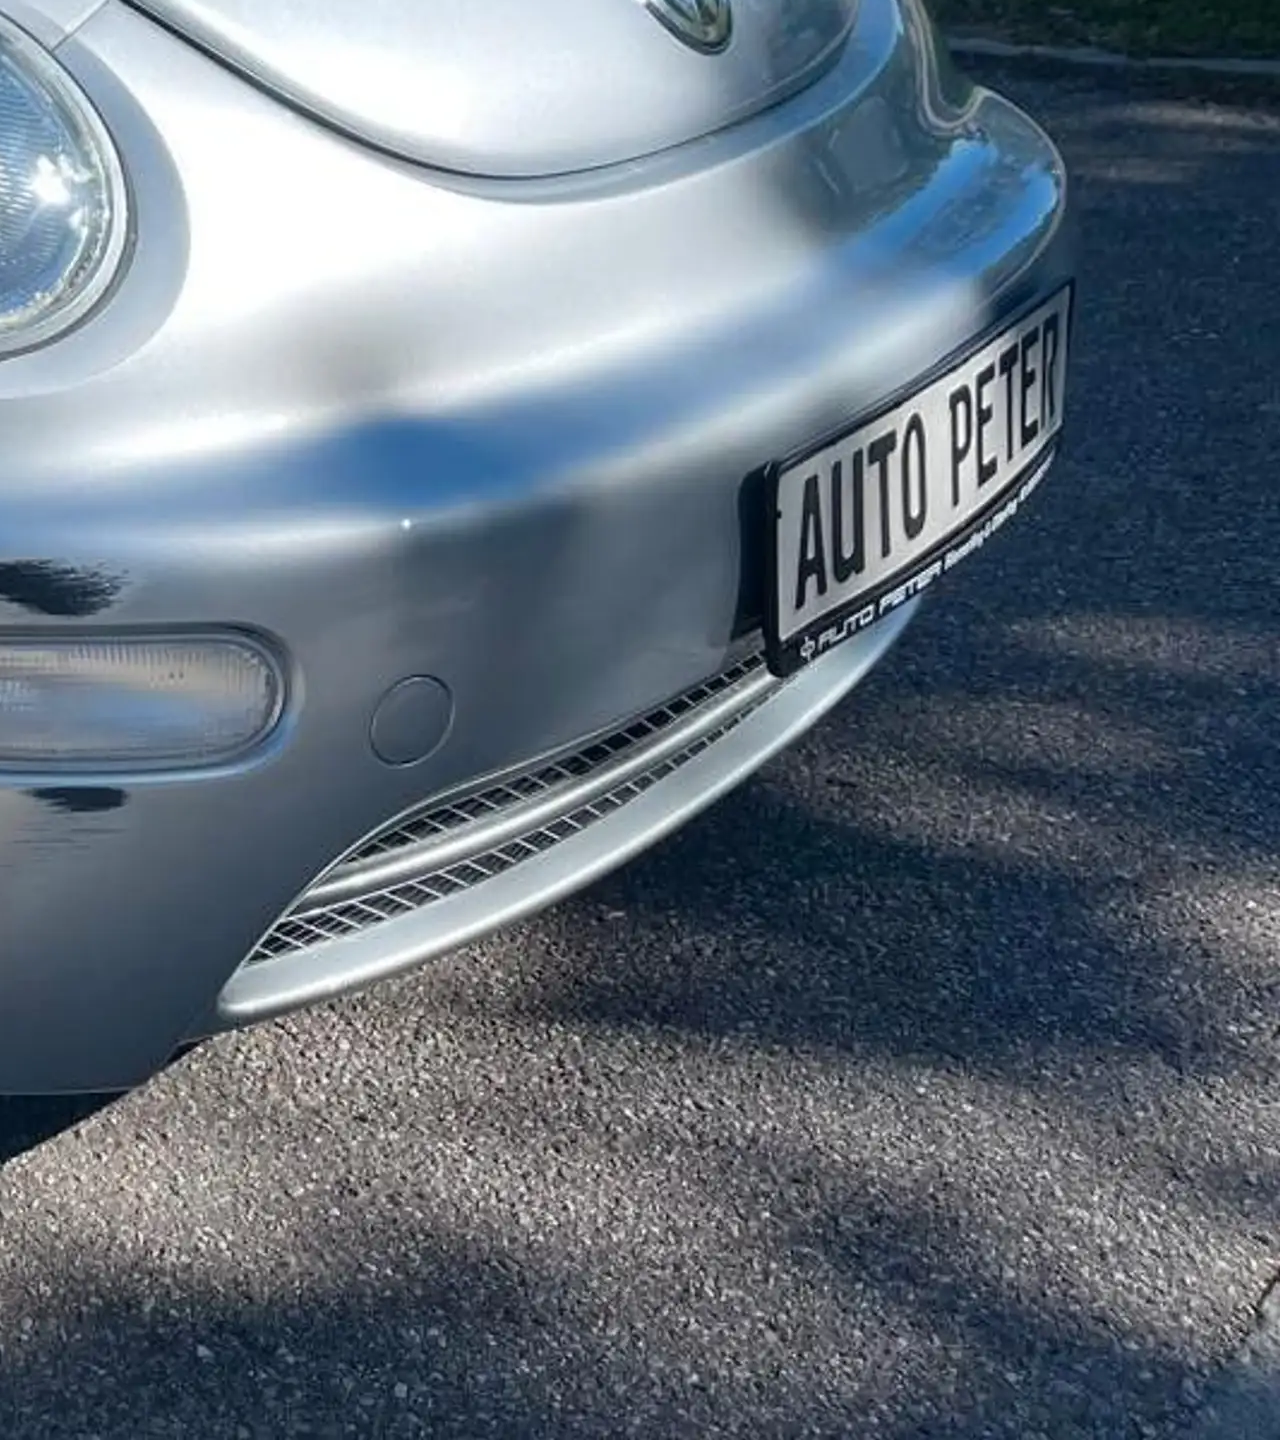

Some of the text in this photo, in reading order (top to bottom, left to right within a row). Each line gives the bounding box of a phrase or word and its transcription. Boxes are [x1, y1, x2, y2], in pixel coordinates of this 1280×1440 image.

[795, 411, 927, 610] AUTO
[948, 312, 1059, 507] PETER
[817, 560, 942, 652] AUTO PETER
